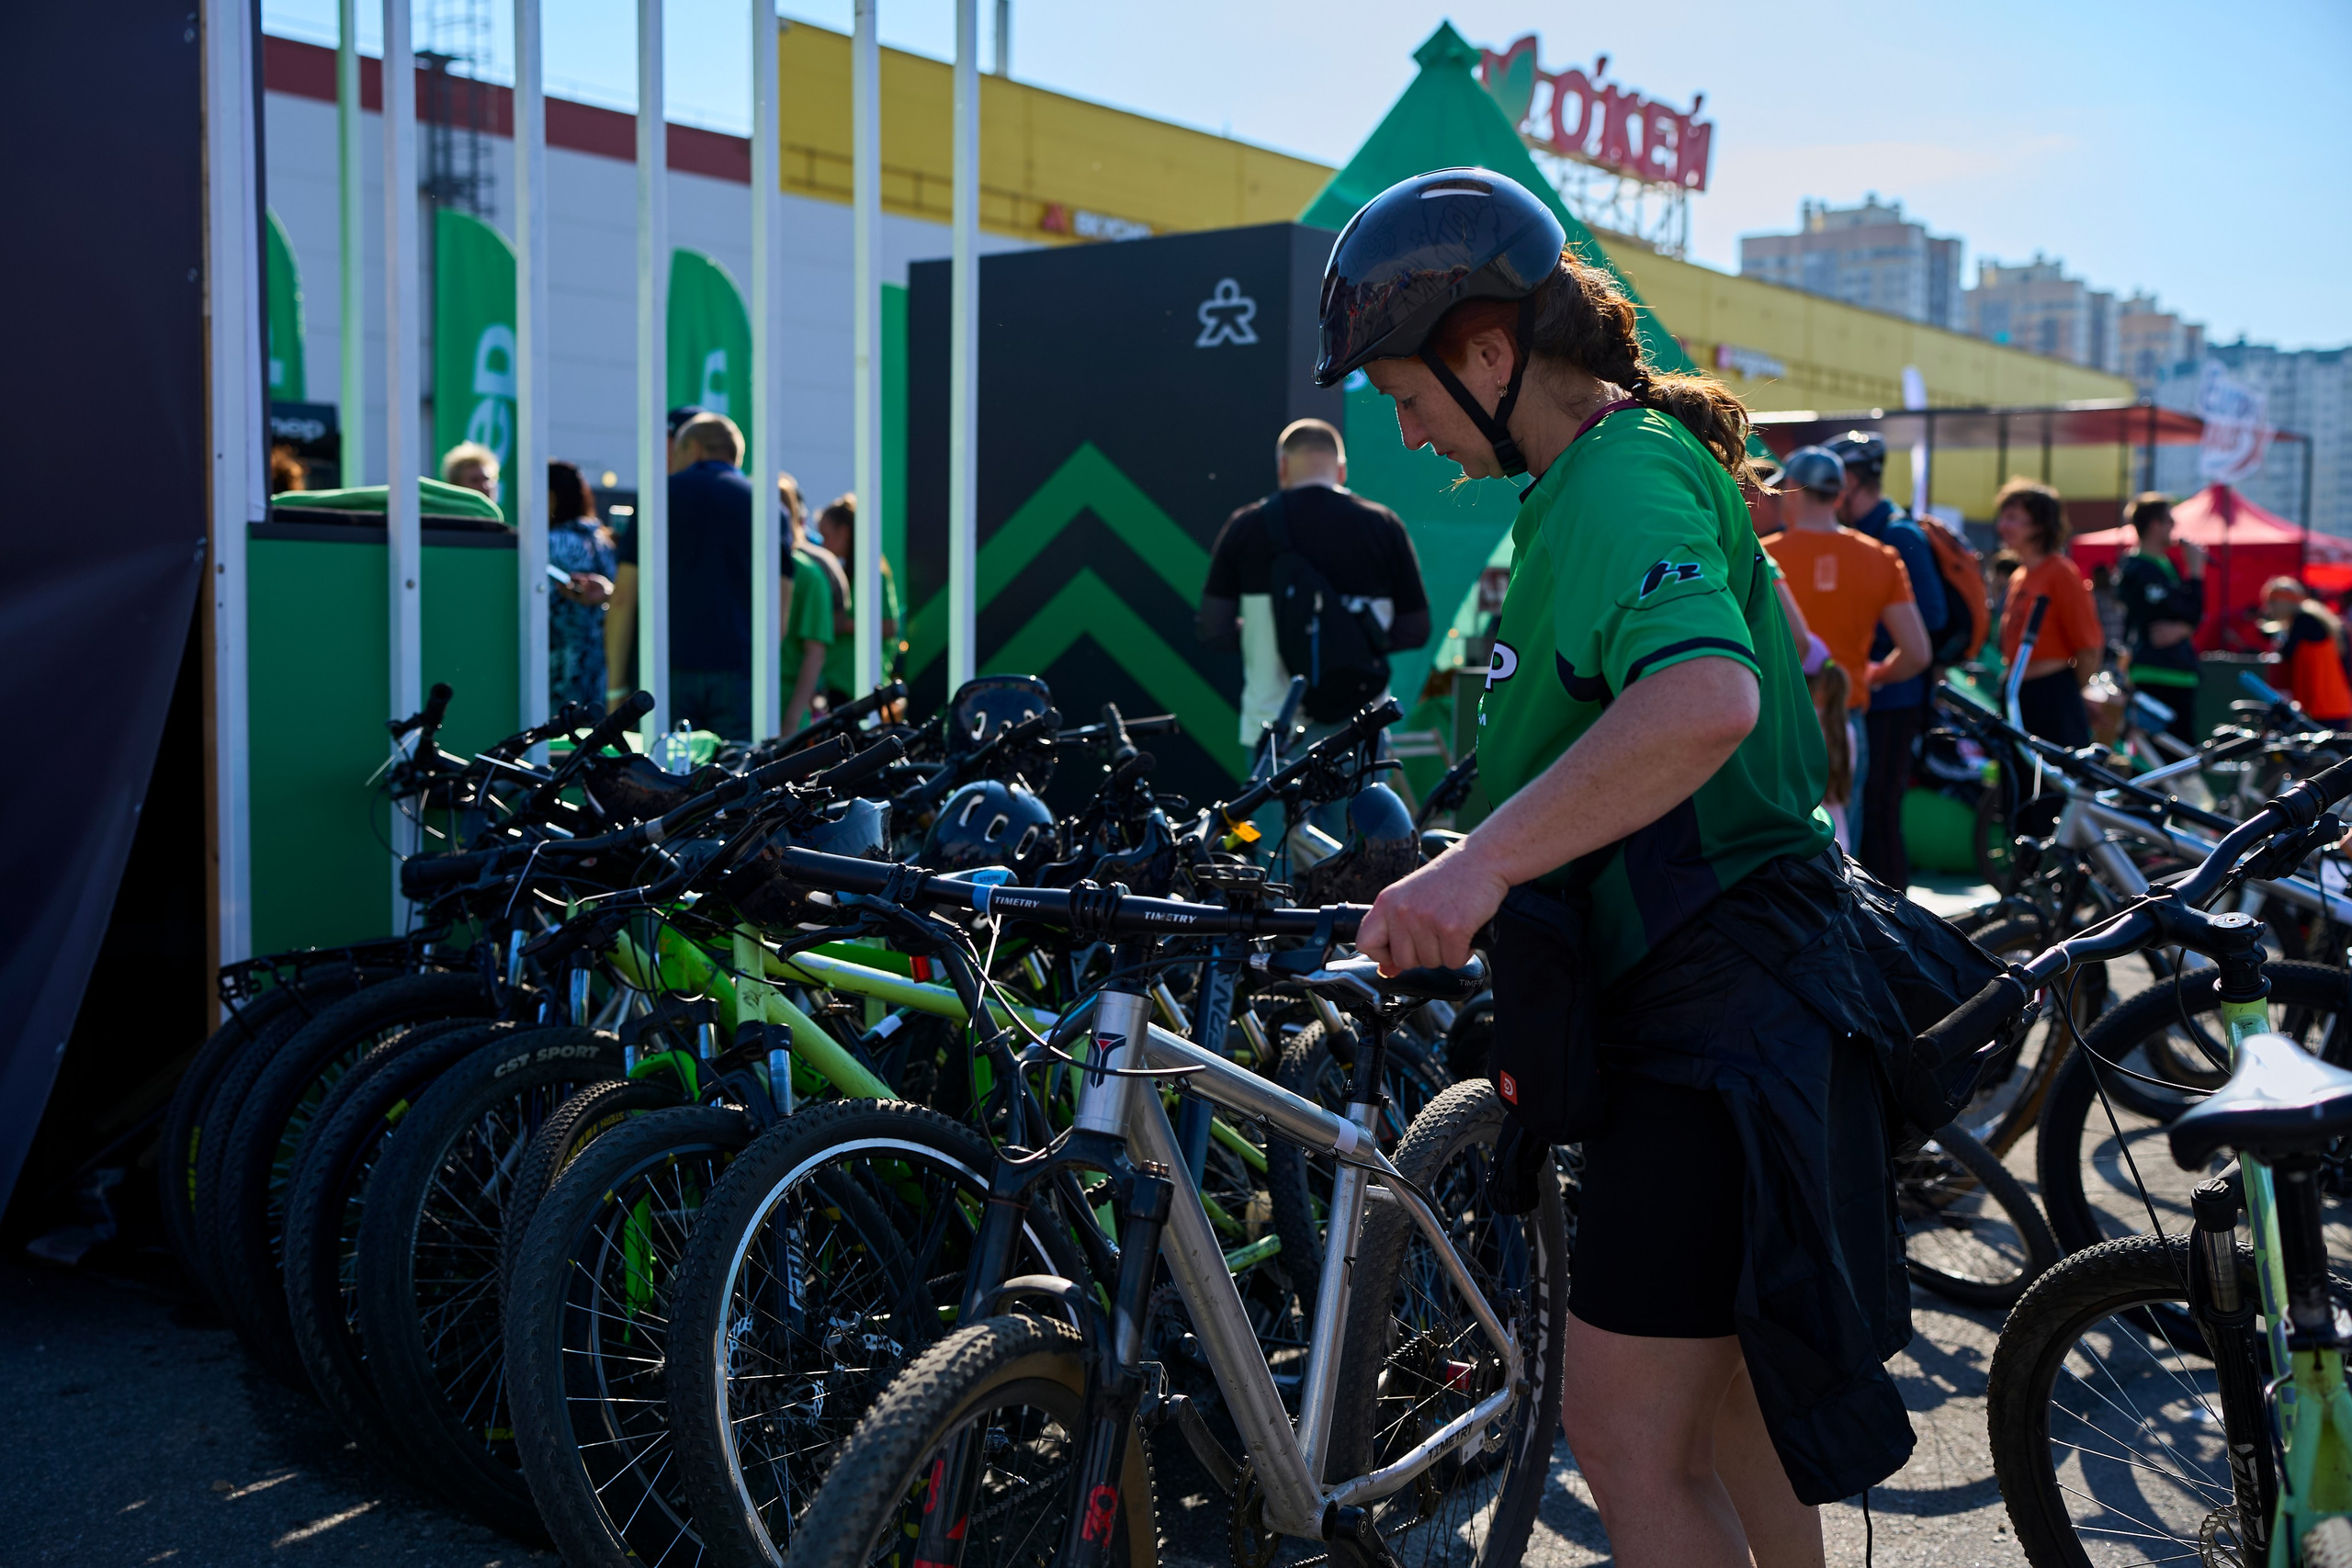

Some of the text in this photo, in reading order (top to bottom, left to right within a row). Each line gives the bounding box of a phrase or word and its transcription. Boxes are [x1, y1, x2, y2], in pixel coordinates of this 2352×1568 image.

[994, 896, 1040, 908] TIMETRY
[1144, 910, 1197, 924] TIMETRY
[493, 1044, 600, 1078] CST SPORT
[1428, 1420, 1474, 1462] TIMETRY
